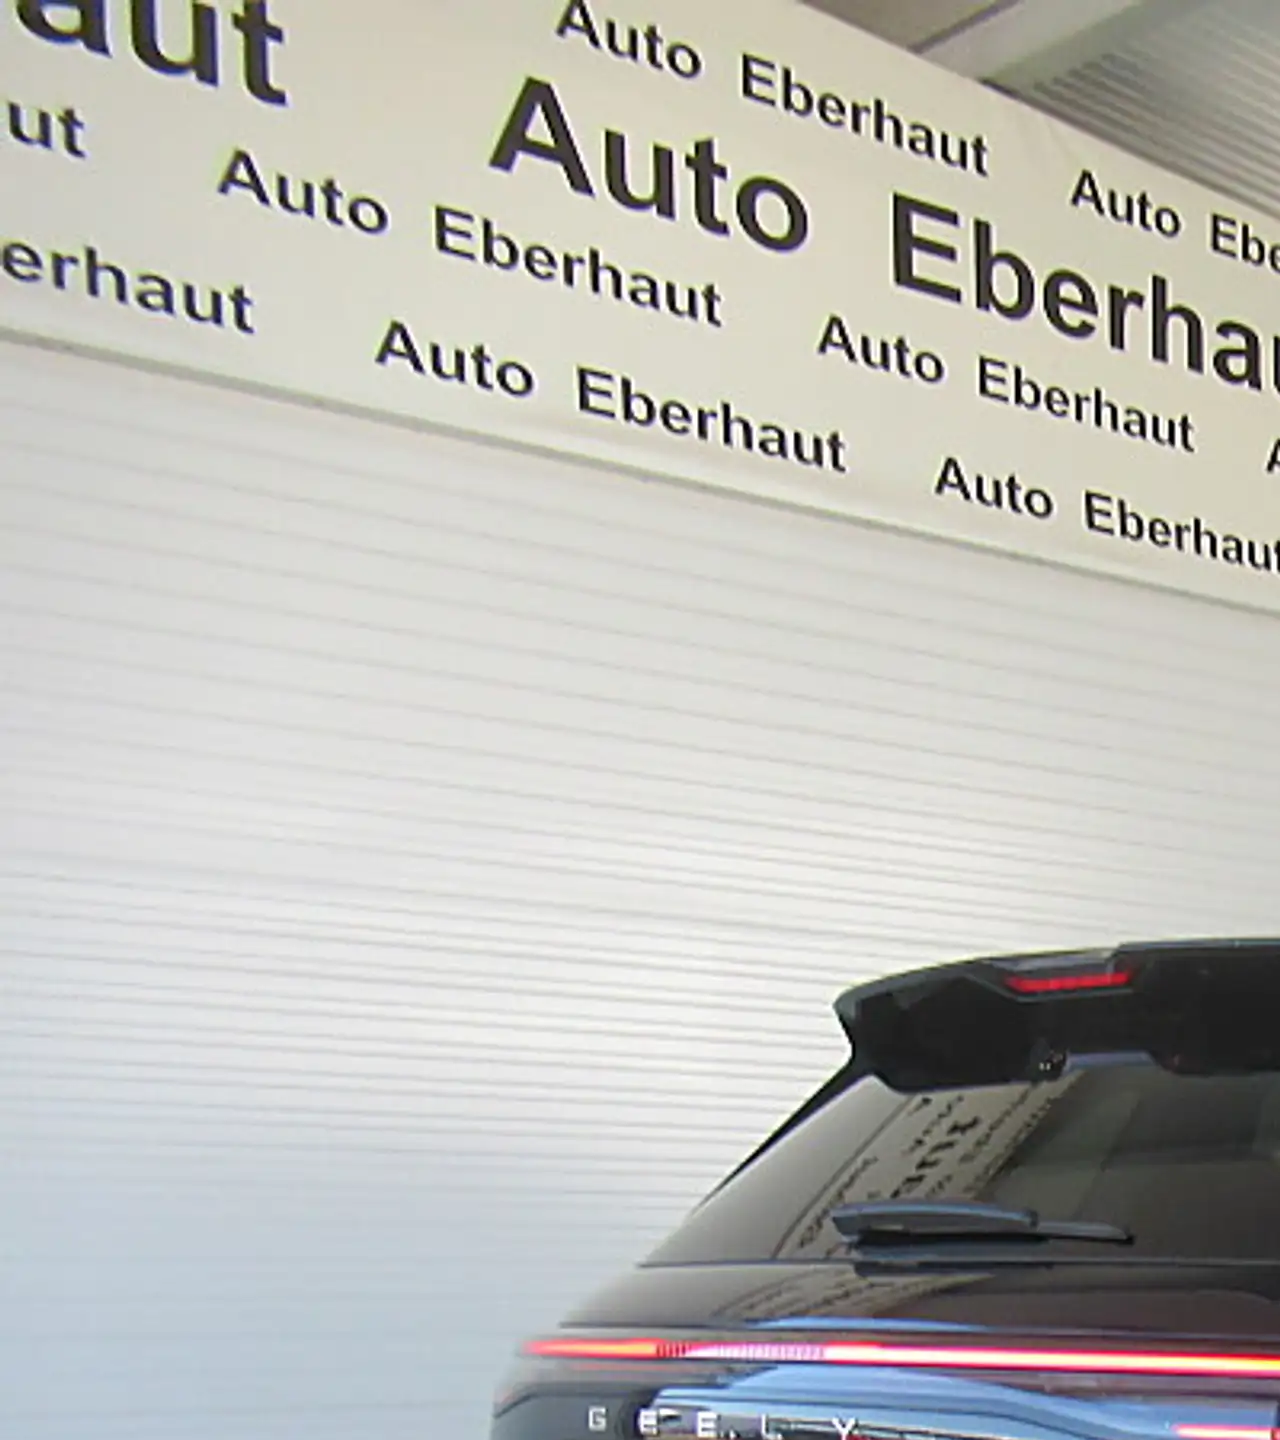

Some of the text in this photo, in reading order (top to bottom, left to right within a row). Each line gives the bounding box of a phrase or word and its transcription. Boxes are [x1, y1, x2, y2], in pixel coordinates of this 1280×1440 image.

[487, 75, 810, 254] Auto
[554, 0, 989, 179] Auto Eberhaut
[216, 148, 723, 329] Auto Eberhaut
[1069, 168, 1183, 240] Auto
[373, 319, 848, 475] Auto Eberhaut
[816, 314, 1196, 454] Auto Eberhaut
[933, 455, 1055, 520] Auto
